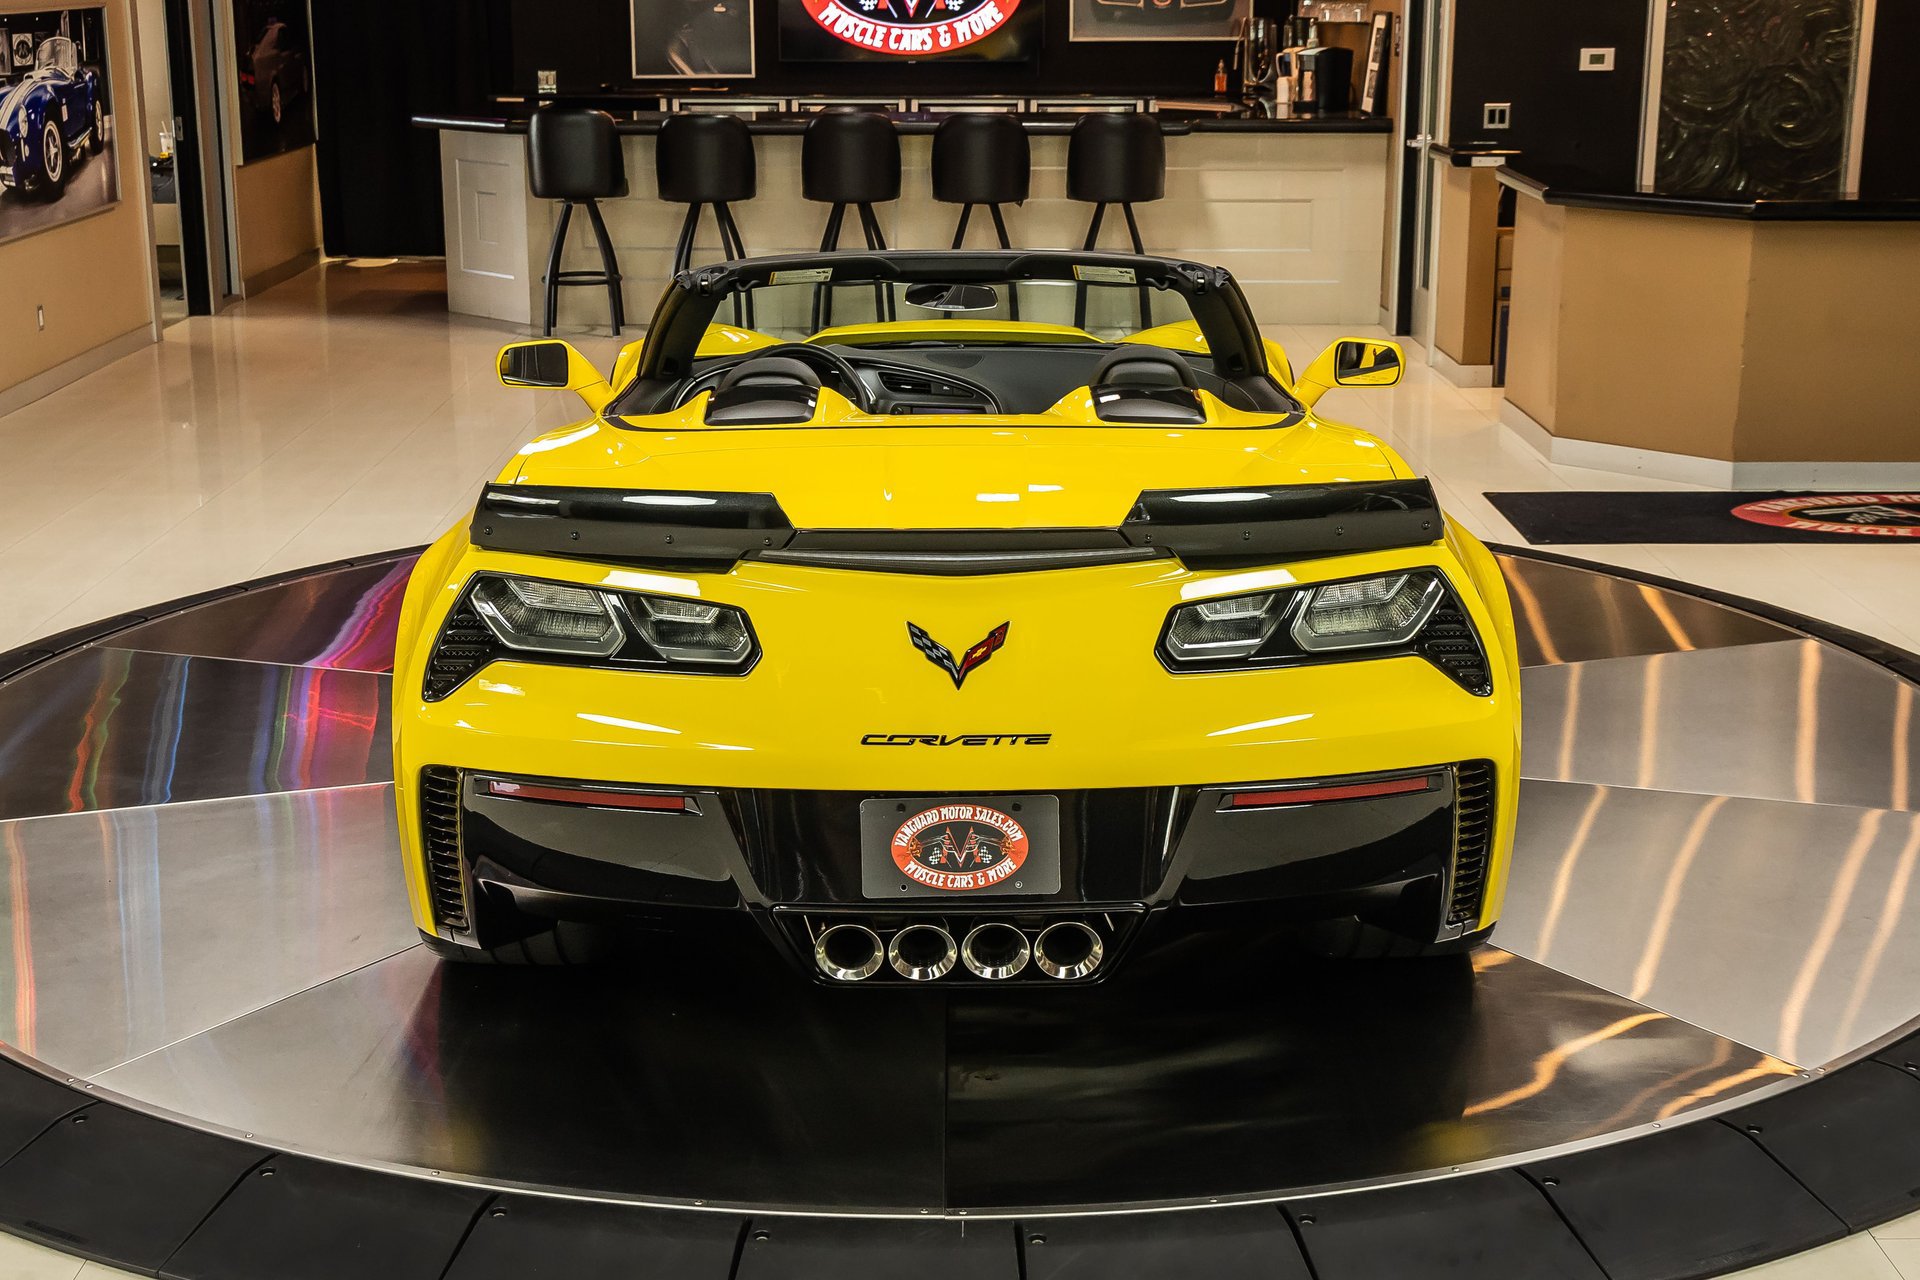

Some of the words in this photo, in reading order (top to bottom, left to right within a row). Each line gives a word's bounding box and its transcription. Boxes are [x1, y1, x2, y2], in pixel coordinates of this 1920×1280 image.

[818, 2, 887, 48] MUSCLE
[889, 27, 932, 51] CARS
[937, 26, 951, 48] &
[953, 1, 1004, 44] MORE
[1784, 521, 1912, 536] MUSCLE
[860, 733, 1052, 746] CORVETTE
[894, 809, 939, 847] VANGUARD
[940, 806, 974, 820] MOTOR
[904, 861, 945, 887] MUSCLE
[947, 873, 974, 888] CARS
[977, 872, 985, 886] &
[988, 857, 1017, 882] MORE
